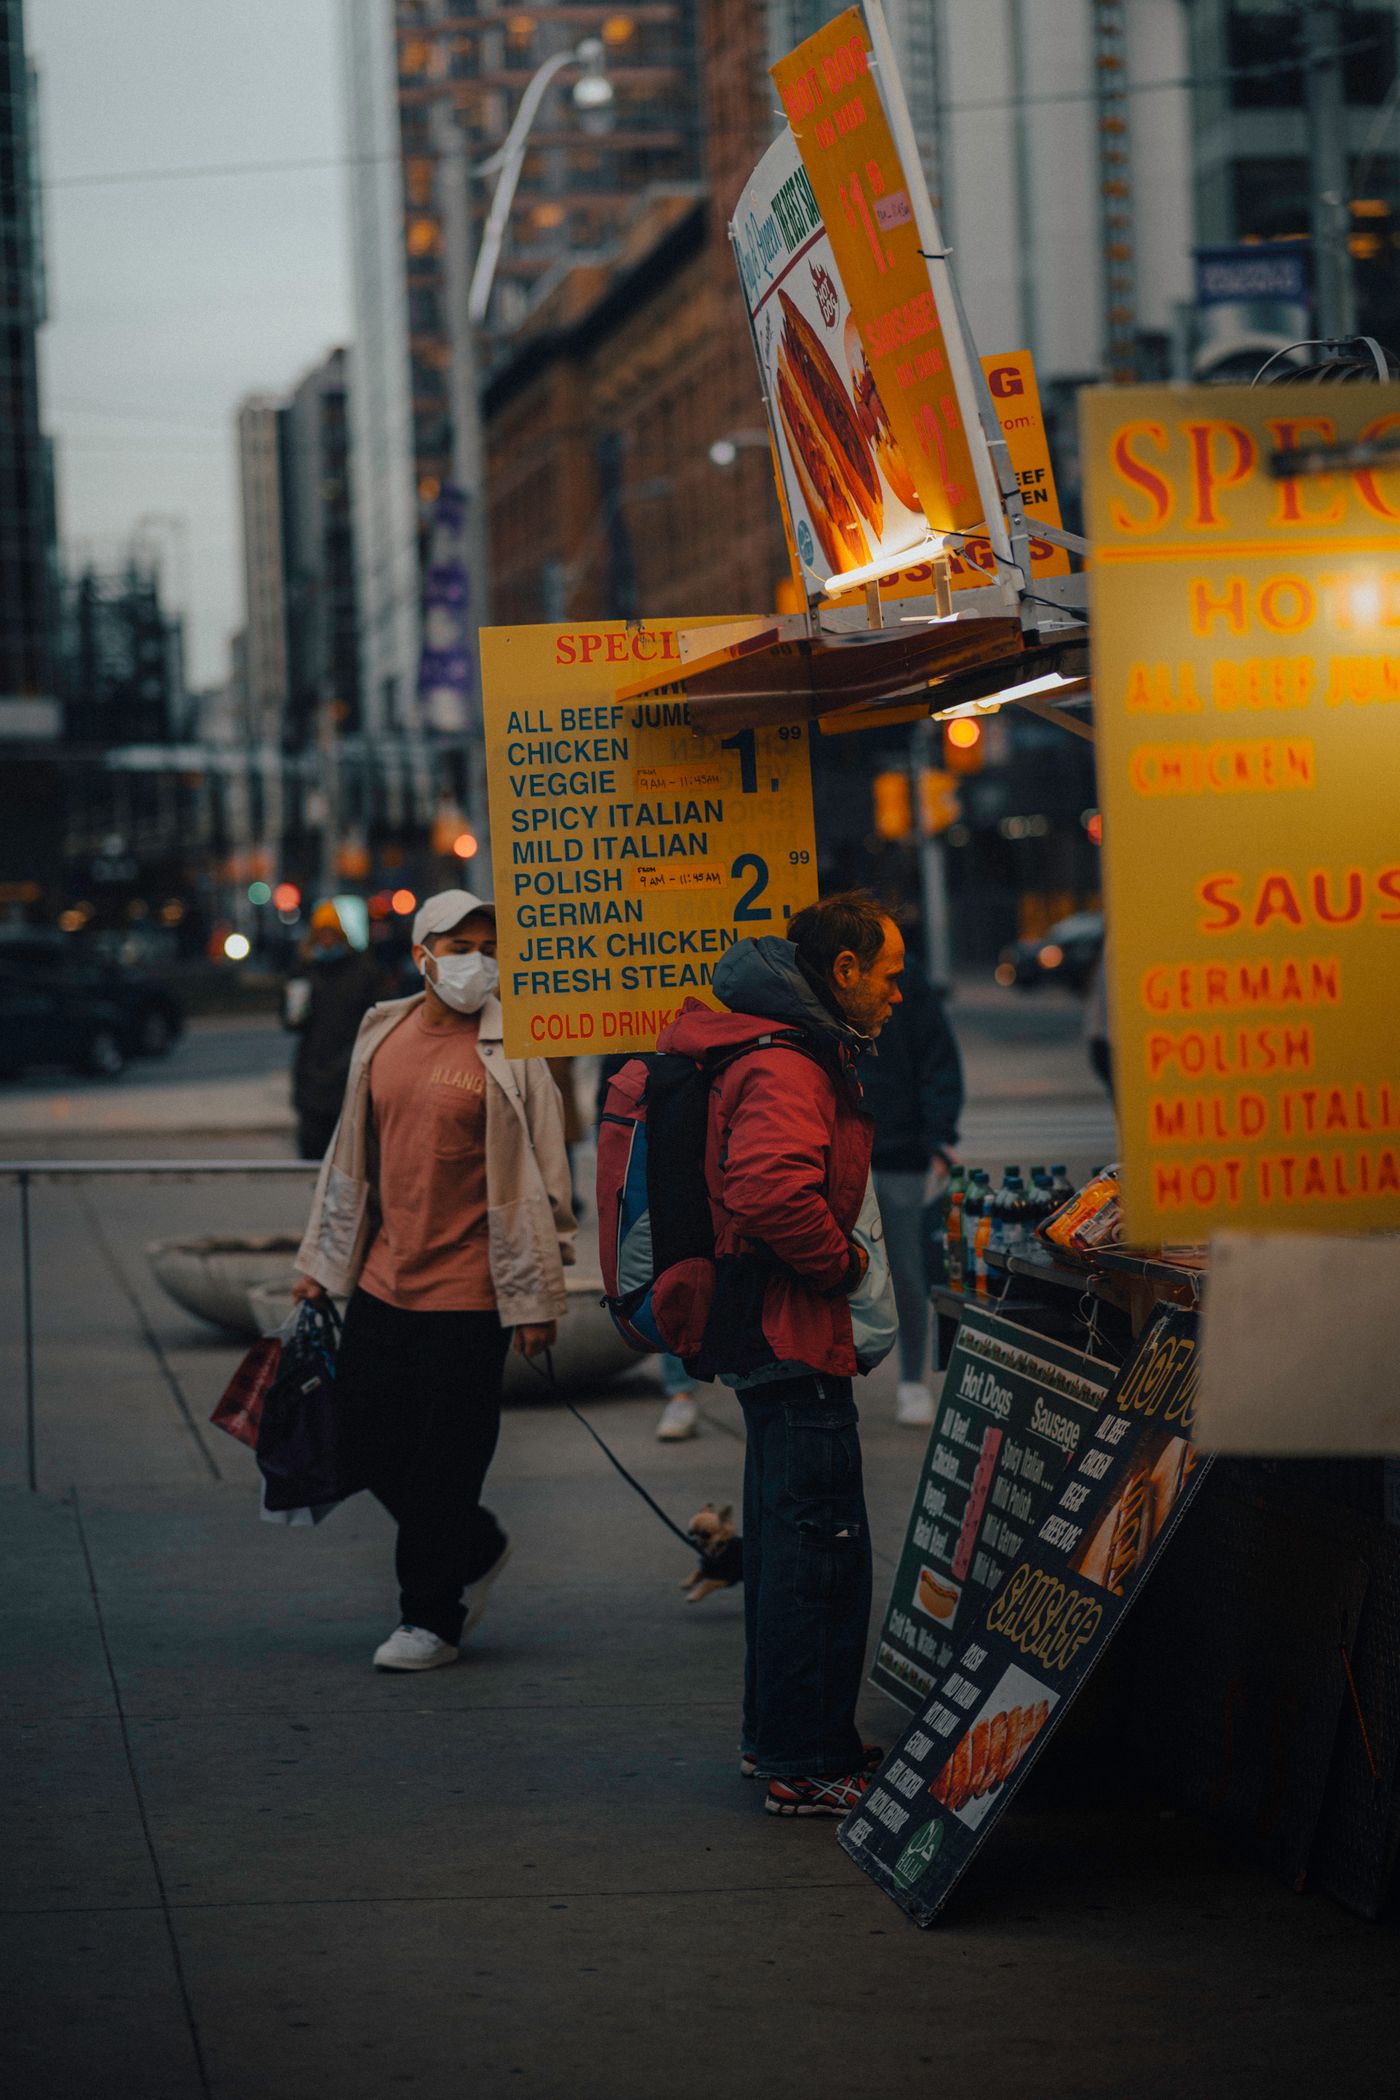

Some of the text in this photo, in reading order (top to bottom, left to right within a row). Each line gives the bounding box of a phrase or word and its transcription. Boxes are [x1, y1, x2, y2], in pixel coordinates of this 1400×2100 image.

[783, 36, 868, 124] HOT DOG
[555, 631, 680, 665] SPECI
[1212, 656, 1317, 711] BEEF
[507, 709, 553, 734] ALL
[561, 705, 624, 731] BEEF
[507, 738, 628, 765] CHICKEN
[1130, 739, 1315, 794] CHICKEN
[509, 770, 616, 797] VEGGIE
[511, 800, 724, 832] SPICY ITALIAN
[512, 832, 708, 864] MILD ITALIAN
[514, 868, 623, 897] POLISH
[516, 900, 643, 928] GERMAN
[519, 928, 739, 962] JERK CHICKEN
[513, 963, 718, 995] FRESH STEAM
[1144, 963, 1340, 1012] GERMAN
[530, 1013, 594, 1041] COLD
[1149, 1029, 1312, 1077] POLISH
[1154, 1088, 1400, 1140] MILD ITALI
[1155, 1161, 1241, 1207] HOT
[960, 1363, 1014, 1419] Hot Dogs
[1030, 1397, 1081, 1452] Sausage
[1094, 1414, 1131, 1445] ALL BEEF
[1077, 1448, 1114, 1480] CHICKEN
[1058, 1480, 1090, 1512] VEGGIE
[1037, 1514, 1083, 1553] CHEESE DOG
[959, 1642, 988, 1672] POLISH
[952, 1680, 981, 1710] ITALIAN
[922, 1699, 960, 1738] HOT ITALIAN
[903, 1729, 934, 1762] GERMAN
[884, 1757, 925, 1799] JERK CHICKEN
[846, 1815, 873, 1846] CHEESE
[878, 1799, 909, 1833] CHEDDAR
[896, 1853, 921, 1883] HALAL
